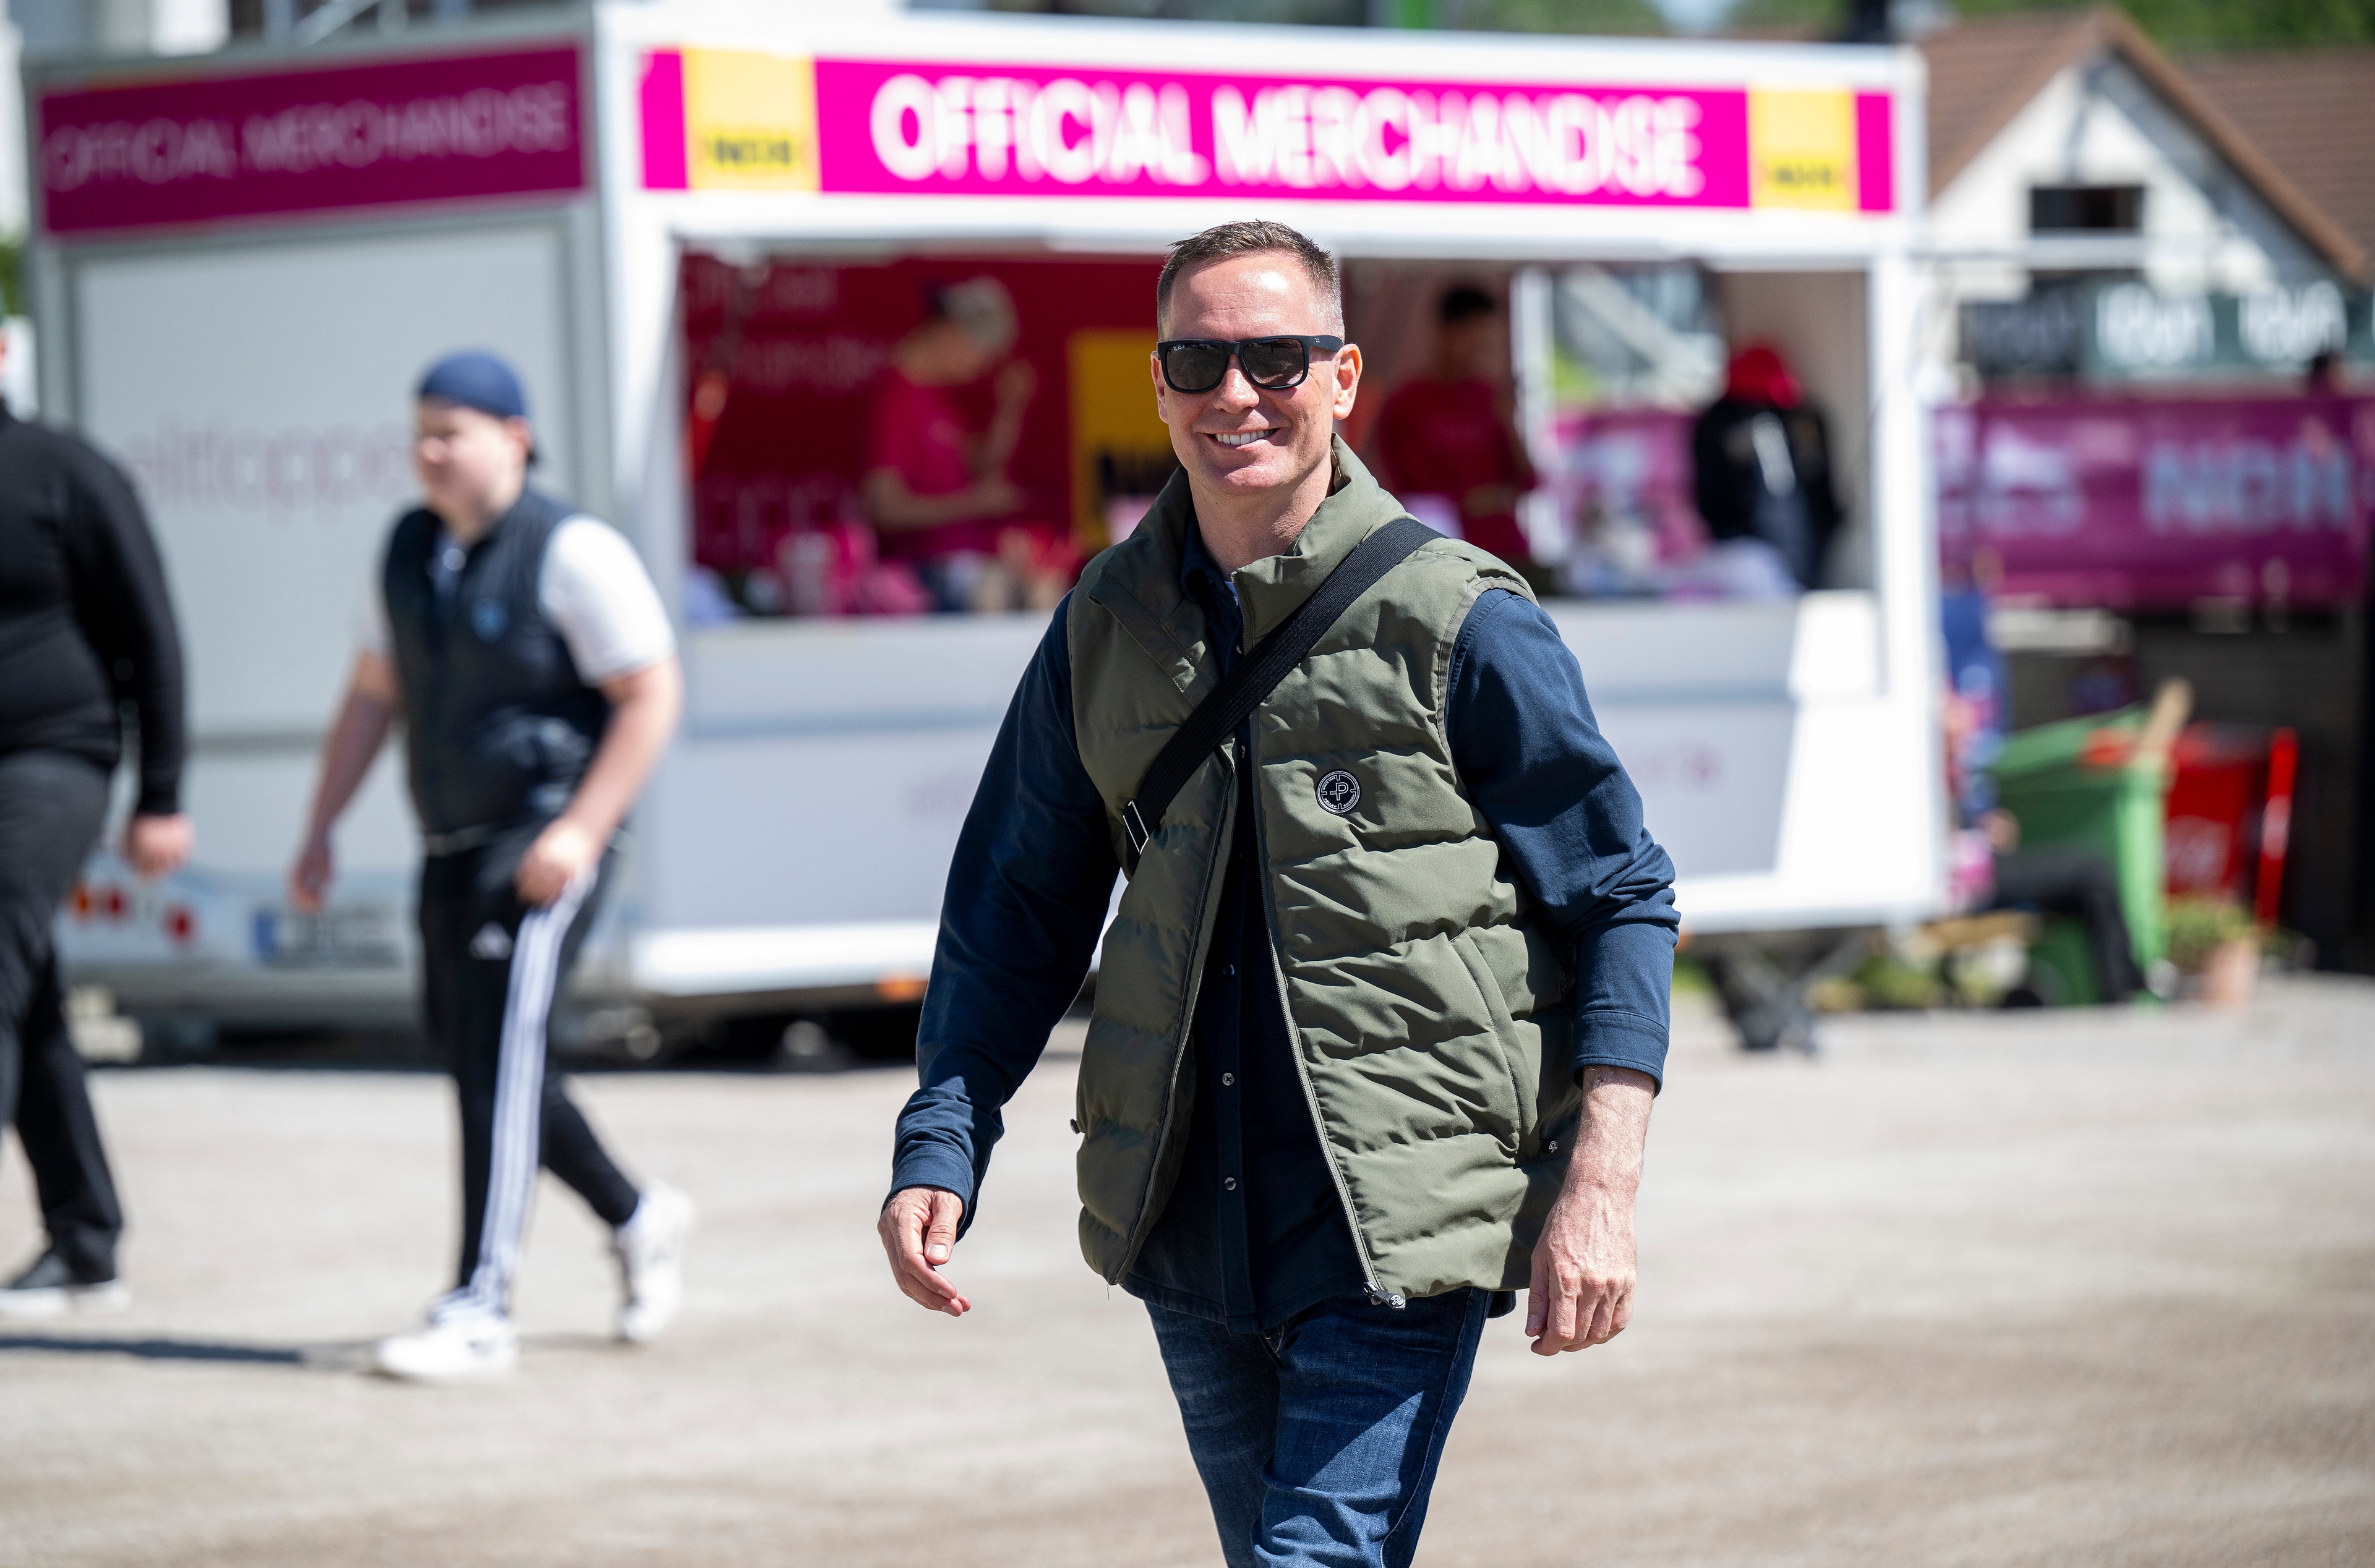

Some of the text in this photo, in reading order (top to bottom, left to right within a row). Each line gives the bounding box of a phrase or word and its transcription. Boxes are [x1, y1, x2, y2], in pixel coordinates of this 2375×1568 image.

[42, 80, 573, 193] OFFICIAL MERCHANDISE
[870, 73, 1705, 198] OFFICIAL MERCHANDISE
